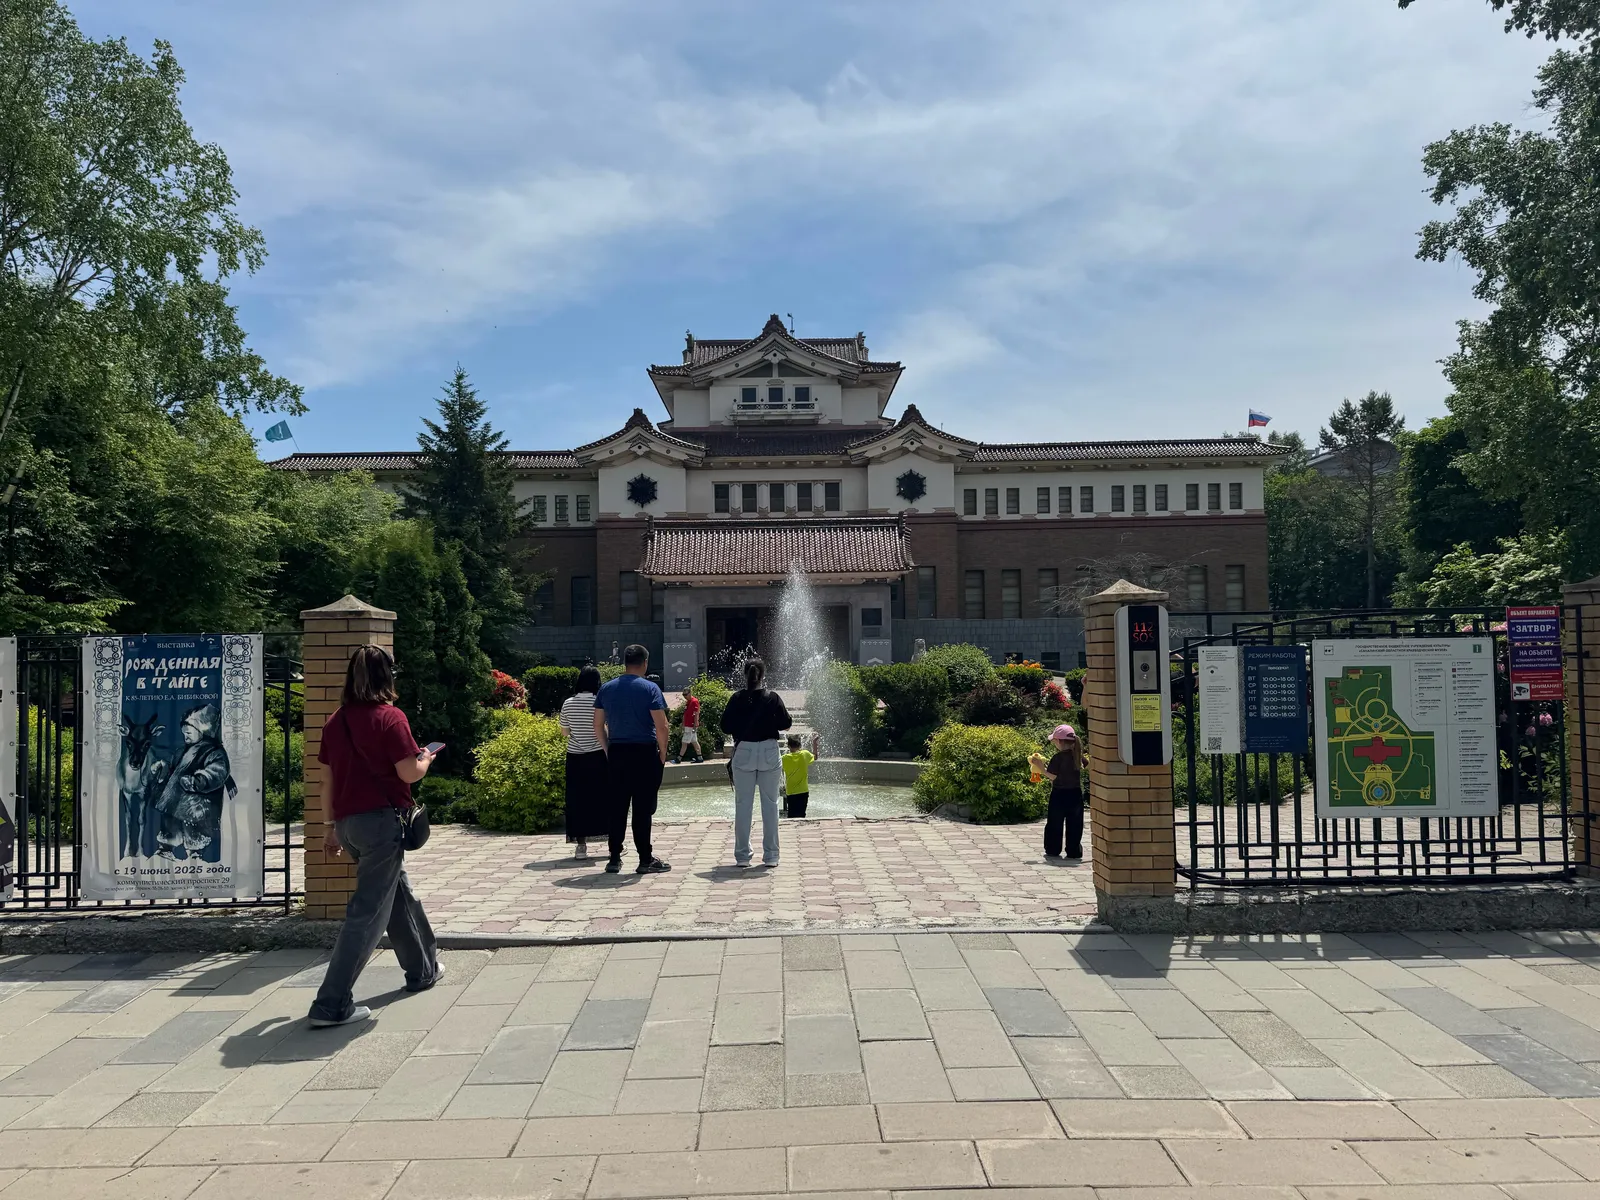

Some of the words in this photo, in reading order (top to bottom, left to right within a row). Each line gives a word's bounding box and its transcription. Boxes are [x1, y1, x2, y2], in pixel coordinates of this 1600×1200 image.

[1134, 622, 1153, 632] 112
[1132, 633, 1154, 642] SOS
[124, 867, 136, 875] 19
[174, 865, 203, 874] 2025
[206, 865, 231, 874] года
